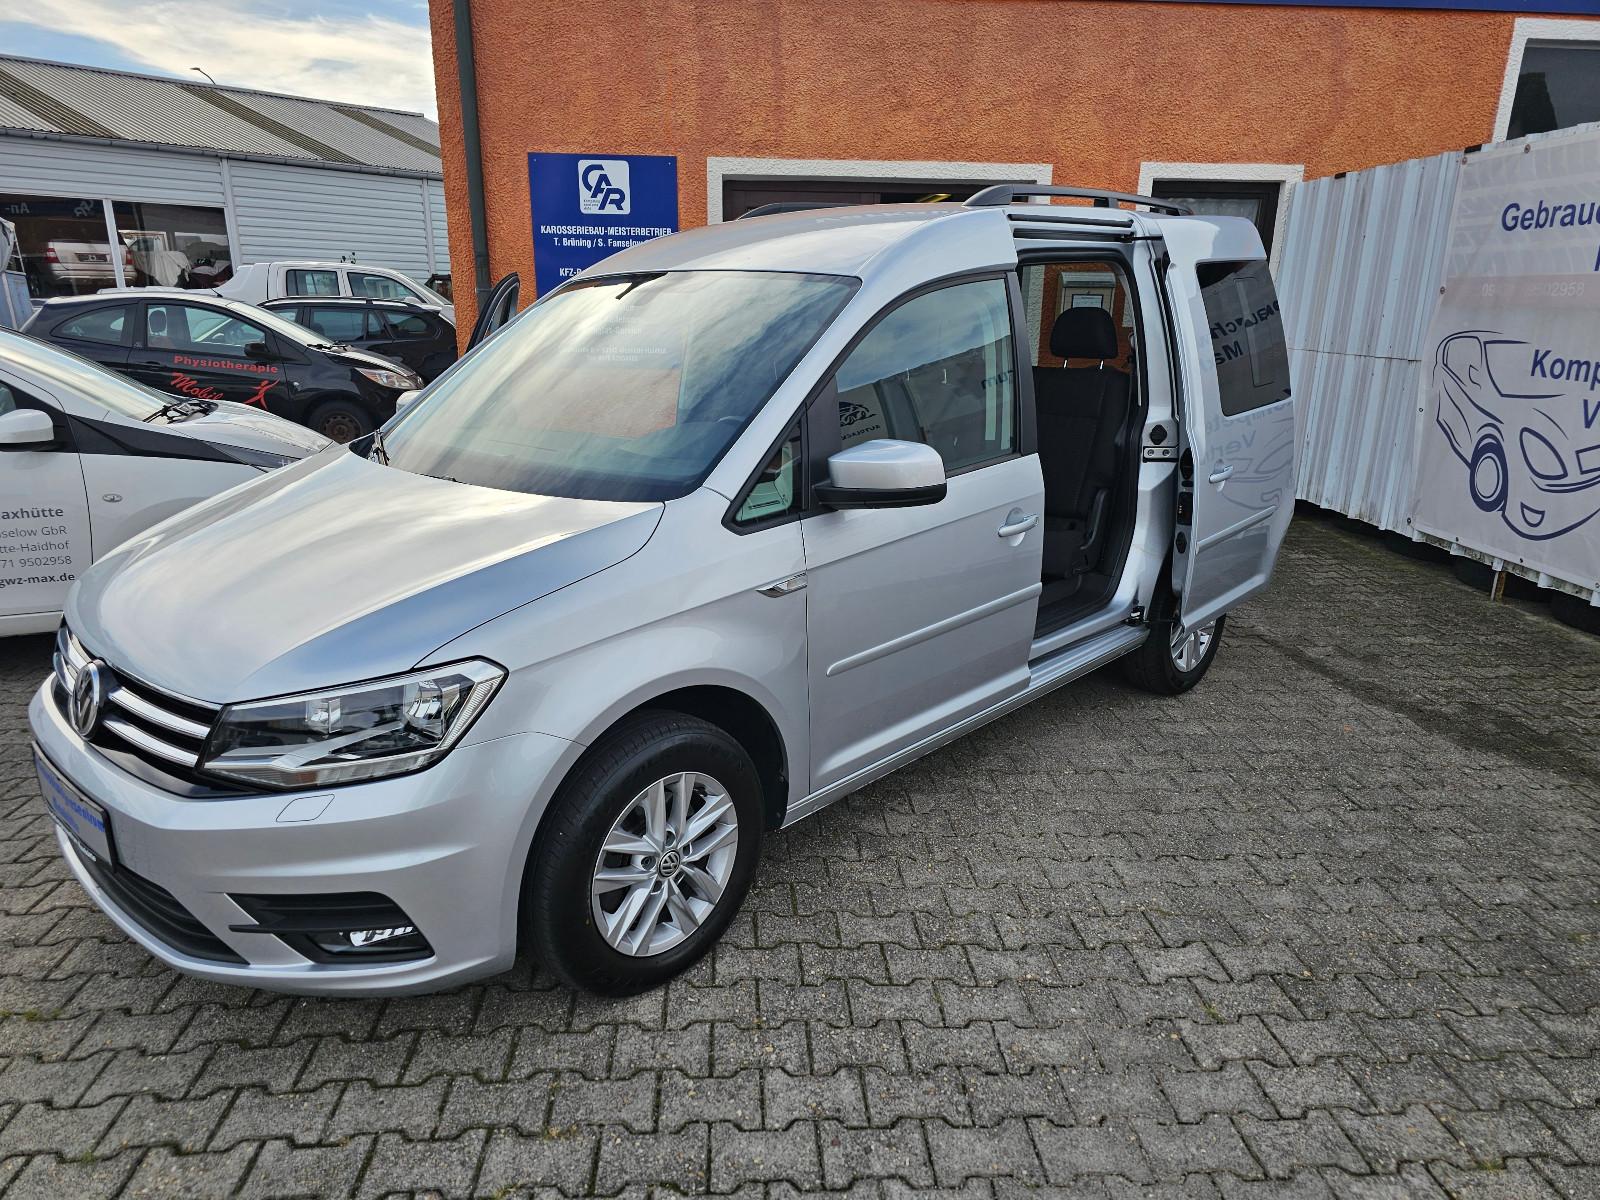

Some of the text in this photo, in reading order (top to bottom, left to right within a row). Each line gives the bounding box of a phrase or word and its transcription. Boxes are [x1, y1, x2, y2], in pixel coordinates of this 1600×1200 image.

[582, 164, 626, 211] CAR
[540, 225, 672, 236] KAROSSERIEBAU-MEISTERBETRIEB
[553, 238, 561, 246] T.
[563, 237, 591, 248] Brüning
[598, 238, 606, 247] S.
[174, 355, 279, 374] Physiotherapie
[170, 371, 224, 400] Mobil
[0, 525, 68, 538] selow GbR
[19, 555, 72, 568] 9502958
